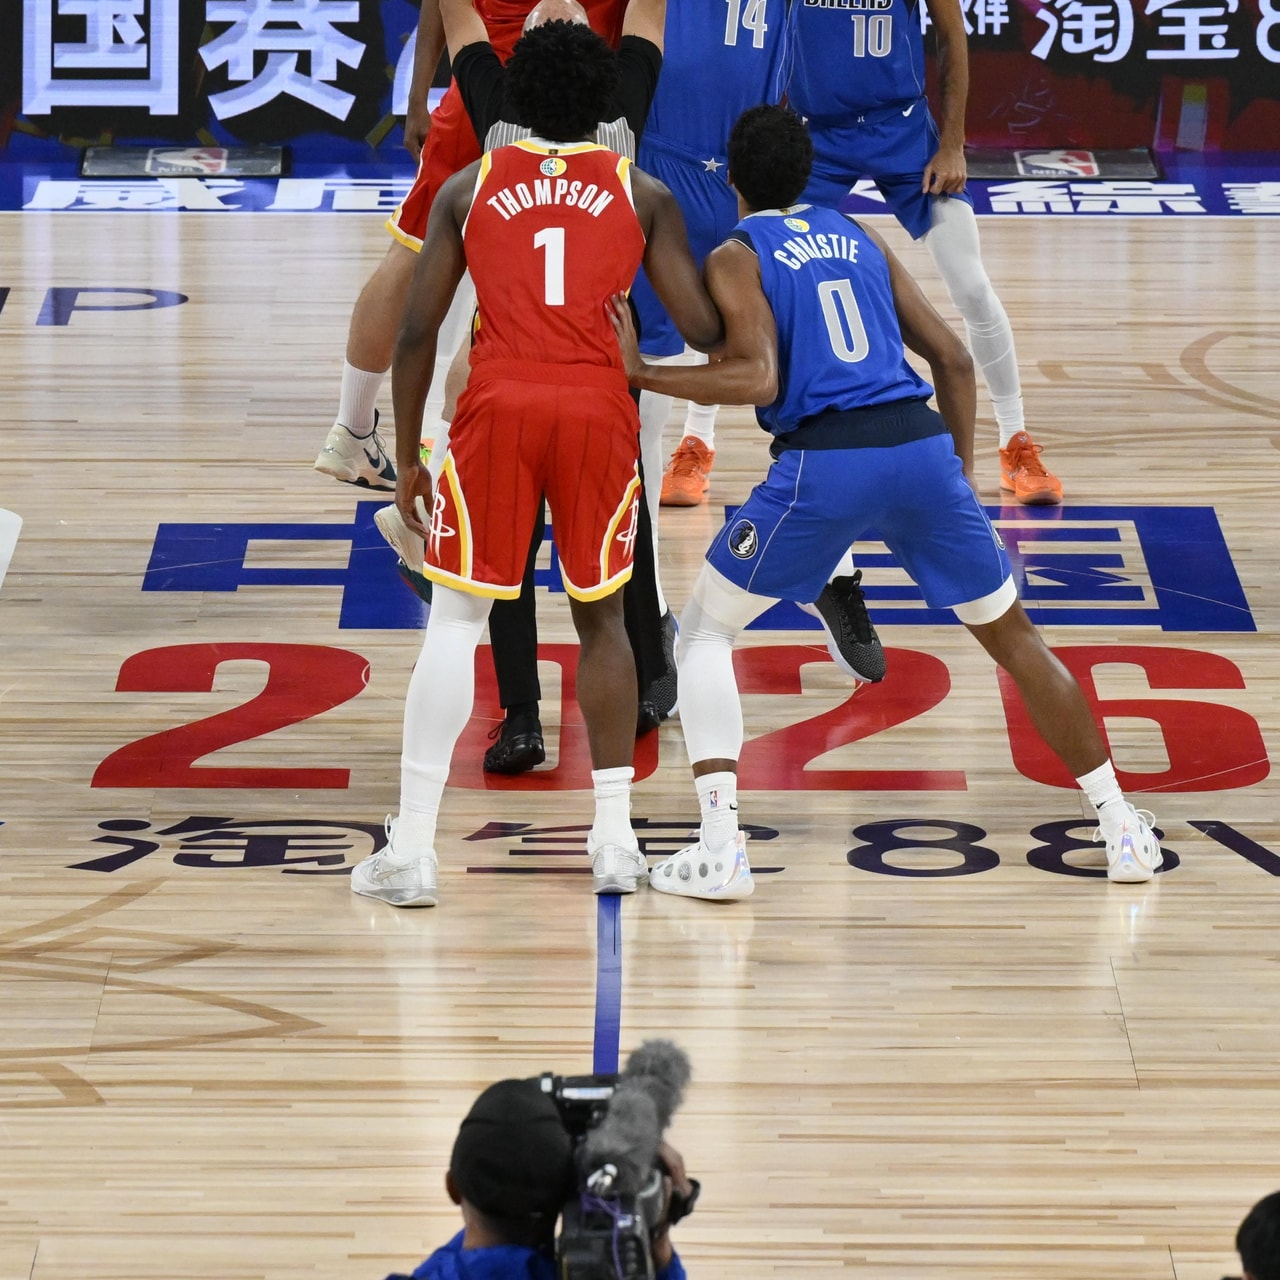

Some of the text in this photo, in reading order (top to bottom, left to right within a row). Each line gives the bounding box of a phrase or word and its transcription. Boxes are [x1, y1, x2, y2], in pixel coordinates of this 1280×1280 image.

[851, 14, 893, 58] 10
[486, 179, 615, 221] THOMPSON
[533, 227, 566, 306] 1
[773, 233, 860, 271] CHRISTIE
[817, 278, 869, 363] 0
[91, 641, 1270, 793] 2026
